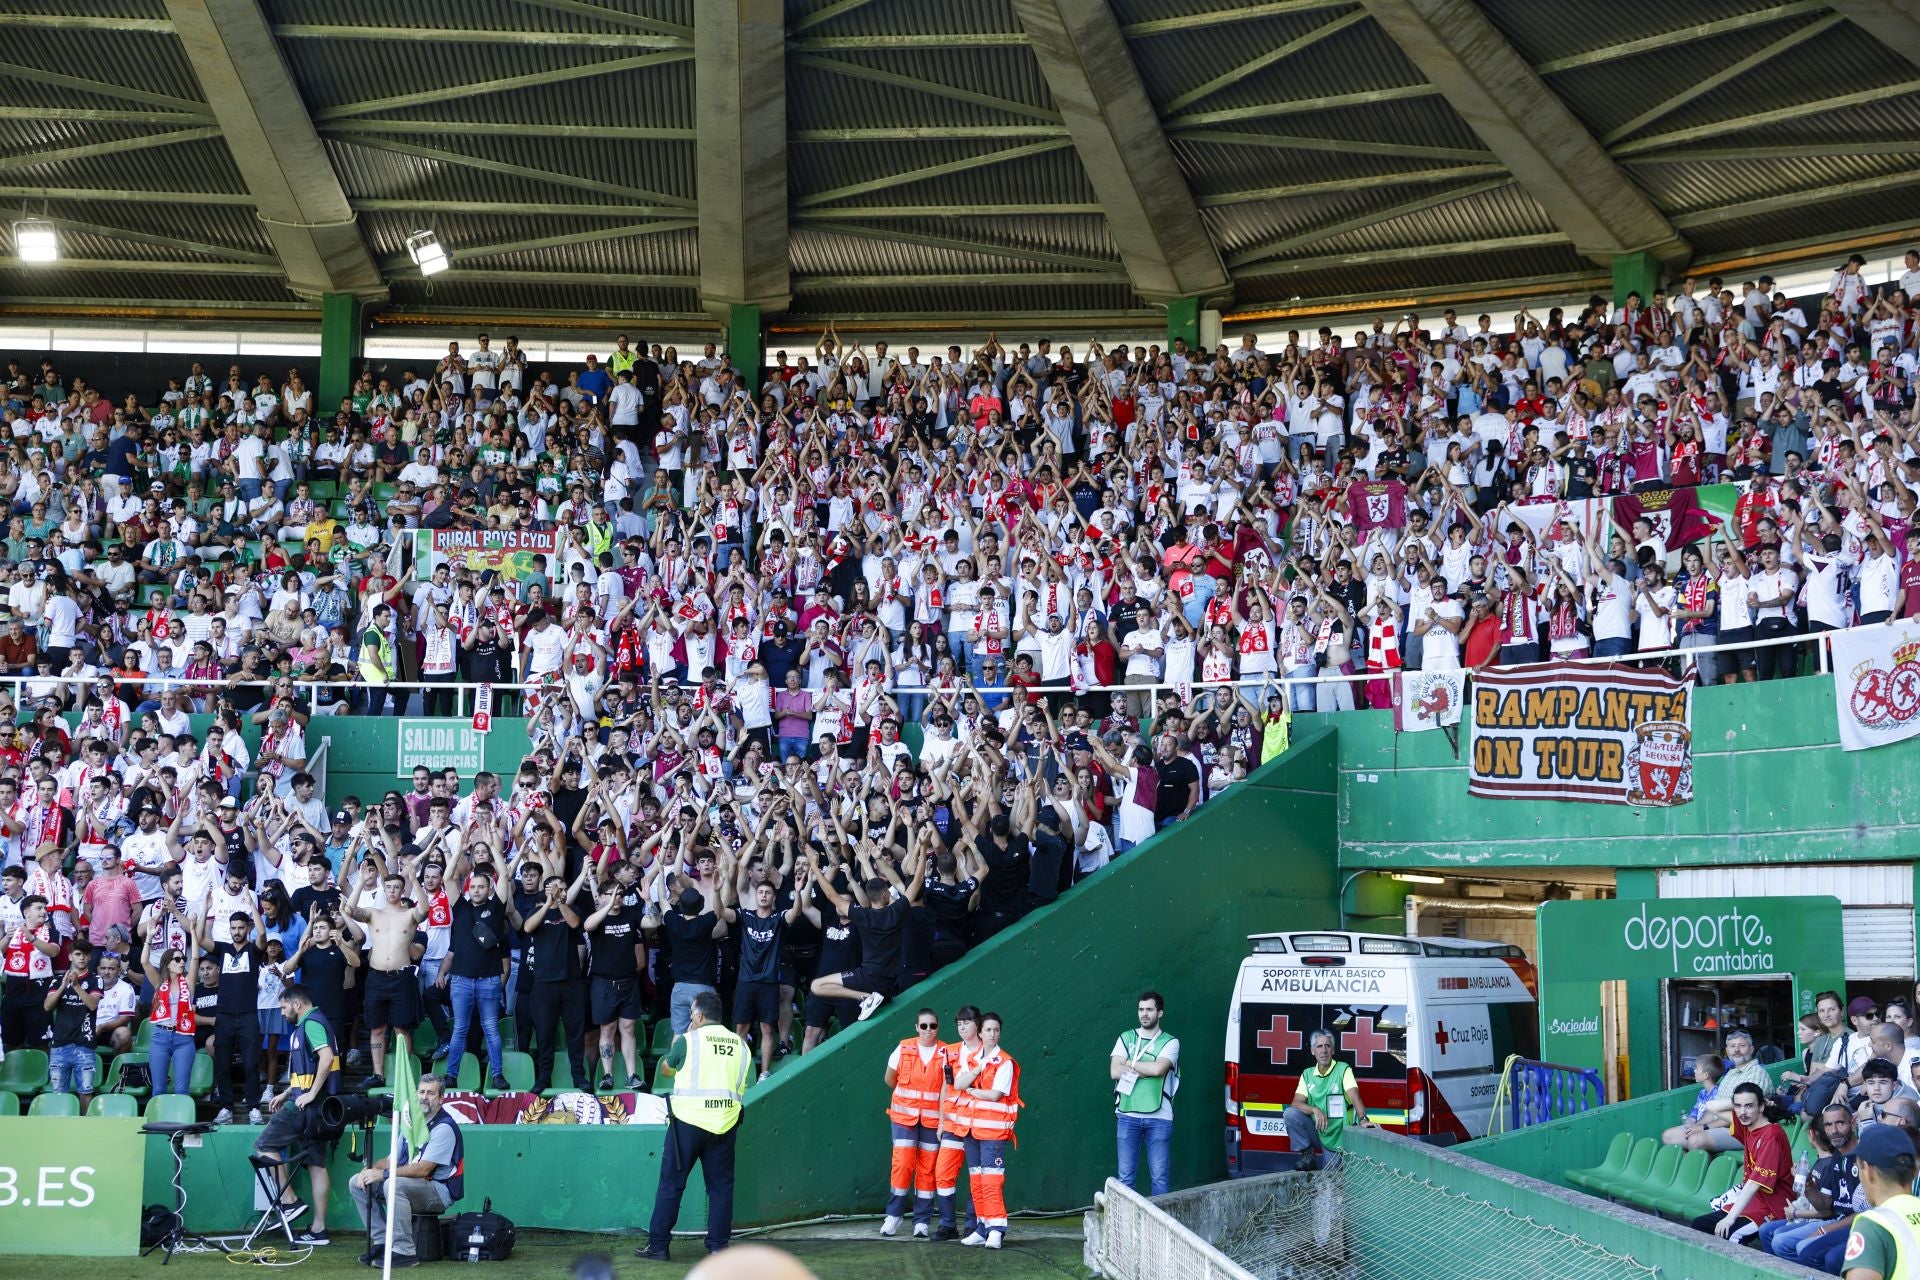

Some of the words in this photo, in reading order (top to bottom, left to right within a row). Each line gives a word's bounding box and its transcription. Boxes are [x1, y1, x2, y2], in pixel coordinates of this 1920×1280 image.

[437, 530, 479, 548] RURAL
[483, 530, 517, 548] BOYS
[520, 532, 553, 549] CYDL
[1422, 674, 1446, 698] CULTURAL
[1476, 686, 1687, 732] RAMPANTES
[404, 728, 455, 752] SALIDA
[460, 728, 478, 752] DE
[403, 754, 478, 769] EMERGENCIAS
[1474, 735, 1523, 779] ON
[1534, 736, 1624, 783] TOUR
[1692, 948, 1774, 972] cantabria
[1263, 969, 1311, 978] SOPORTE
[1314, 969, 1343, 978] VITAL
[1346, 970, 1386, 978] BASICO
[1470, 977, 1511, 989] AMBULANCIA
[1261, 979, 1381, 993] AMBULANCIA
[1551, 1015, 1599, 1035] Sociedad
[705, 1035, 739, 1046] SEGURIDAD
[1451, 1027, 1470, 1043] Cruz
[1471, 1025, 1489, 1045] Roja
[713, 1044, 734, 1057] 152
[1470, 1084, 1496, 1097] SOPORTE
[1262, 1121, 1285, 1132] 3662
[0, 1165, 96, 1208] B.ES
